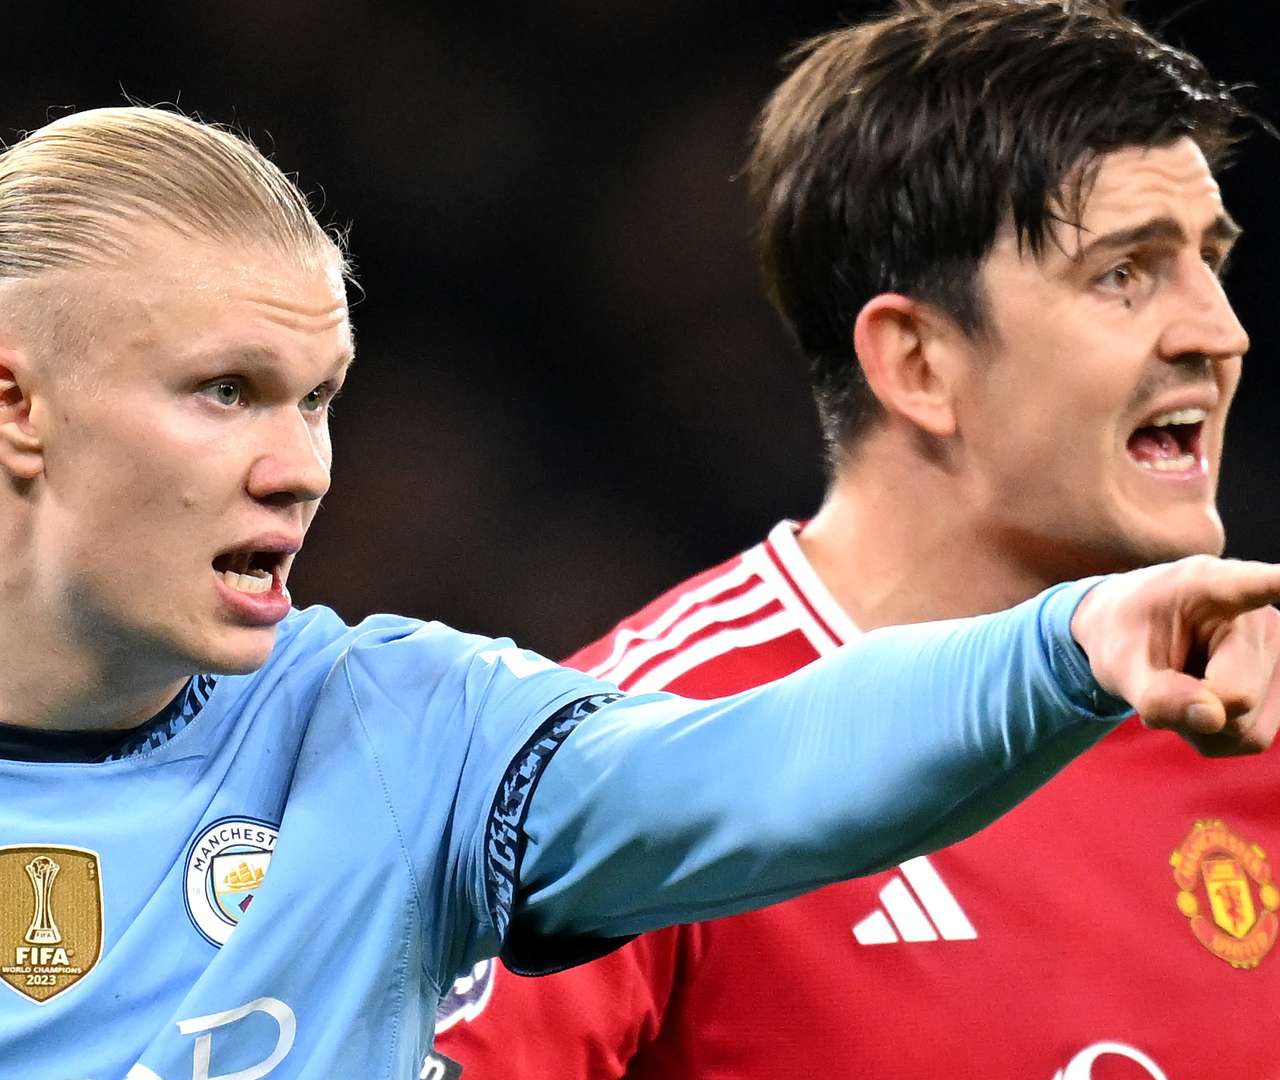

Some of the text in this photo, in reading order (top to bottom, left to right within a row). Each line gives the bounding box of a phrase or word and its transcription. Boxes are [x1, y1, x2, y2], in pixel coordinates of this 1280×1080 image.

[16, 947, 69, 965] FIFA
[33, 966, 82, 974] CHAMPIONS
[26, 975, 57, 986] 2023
